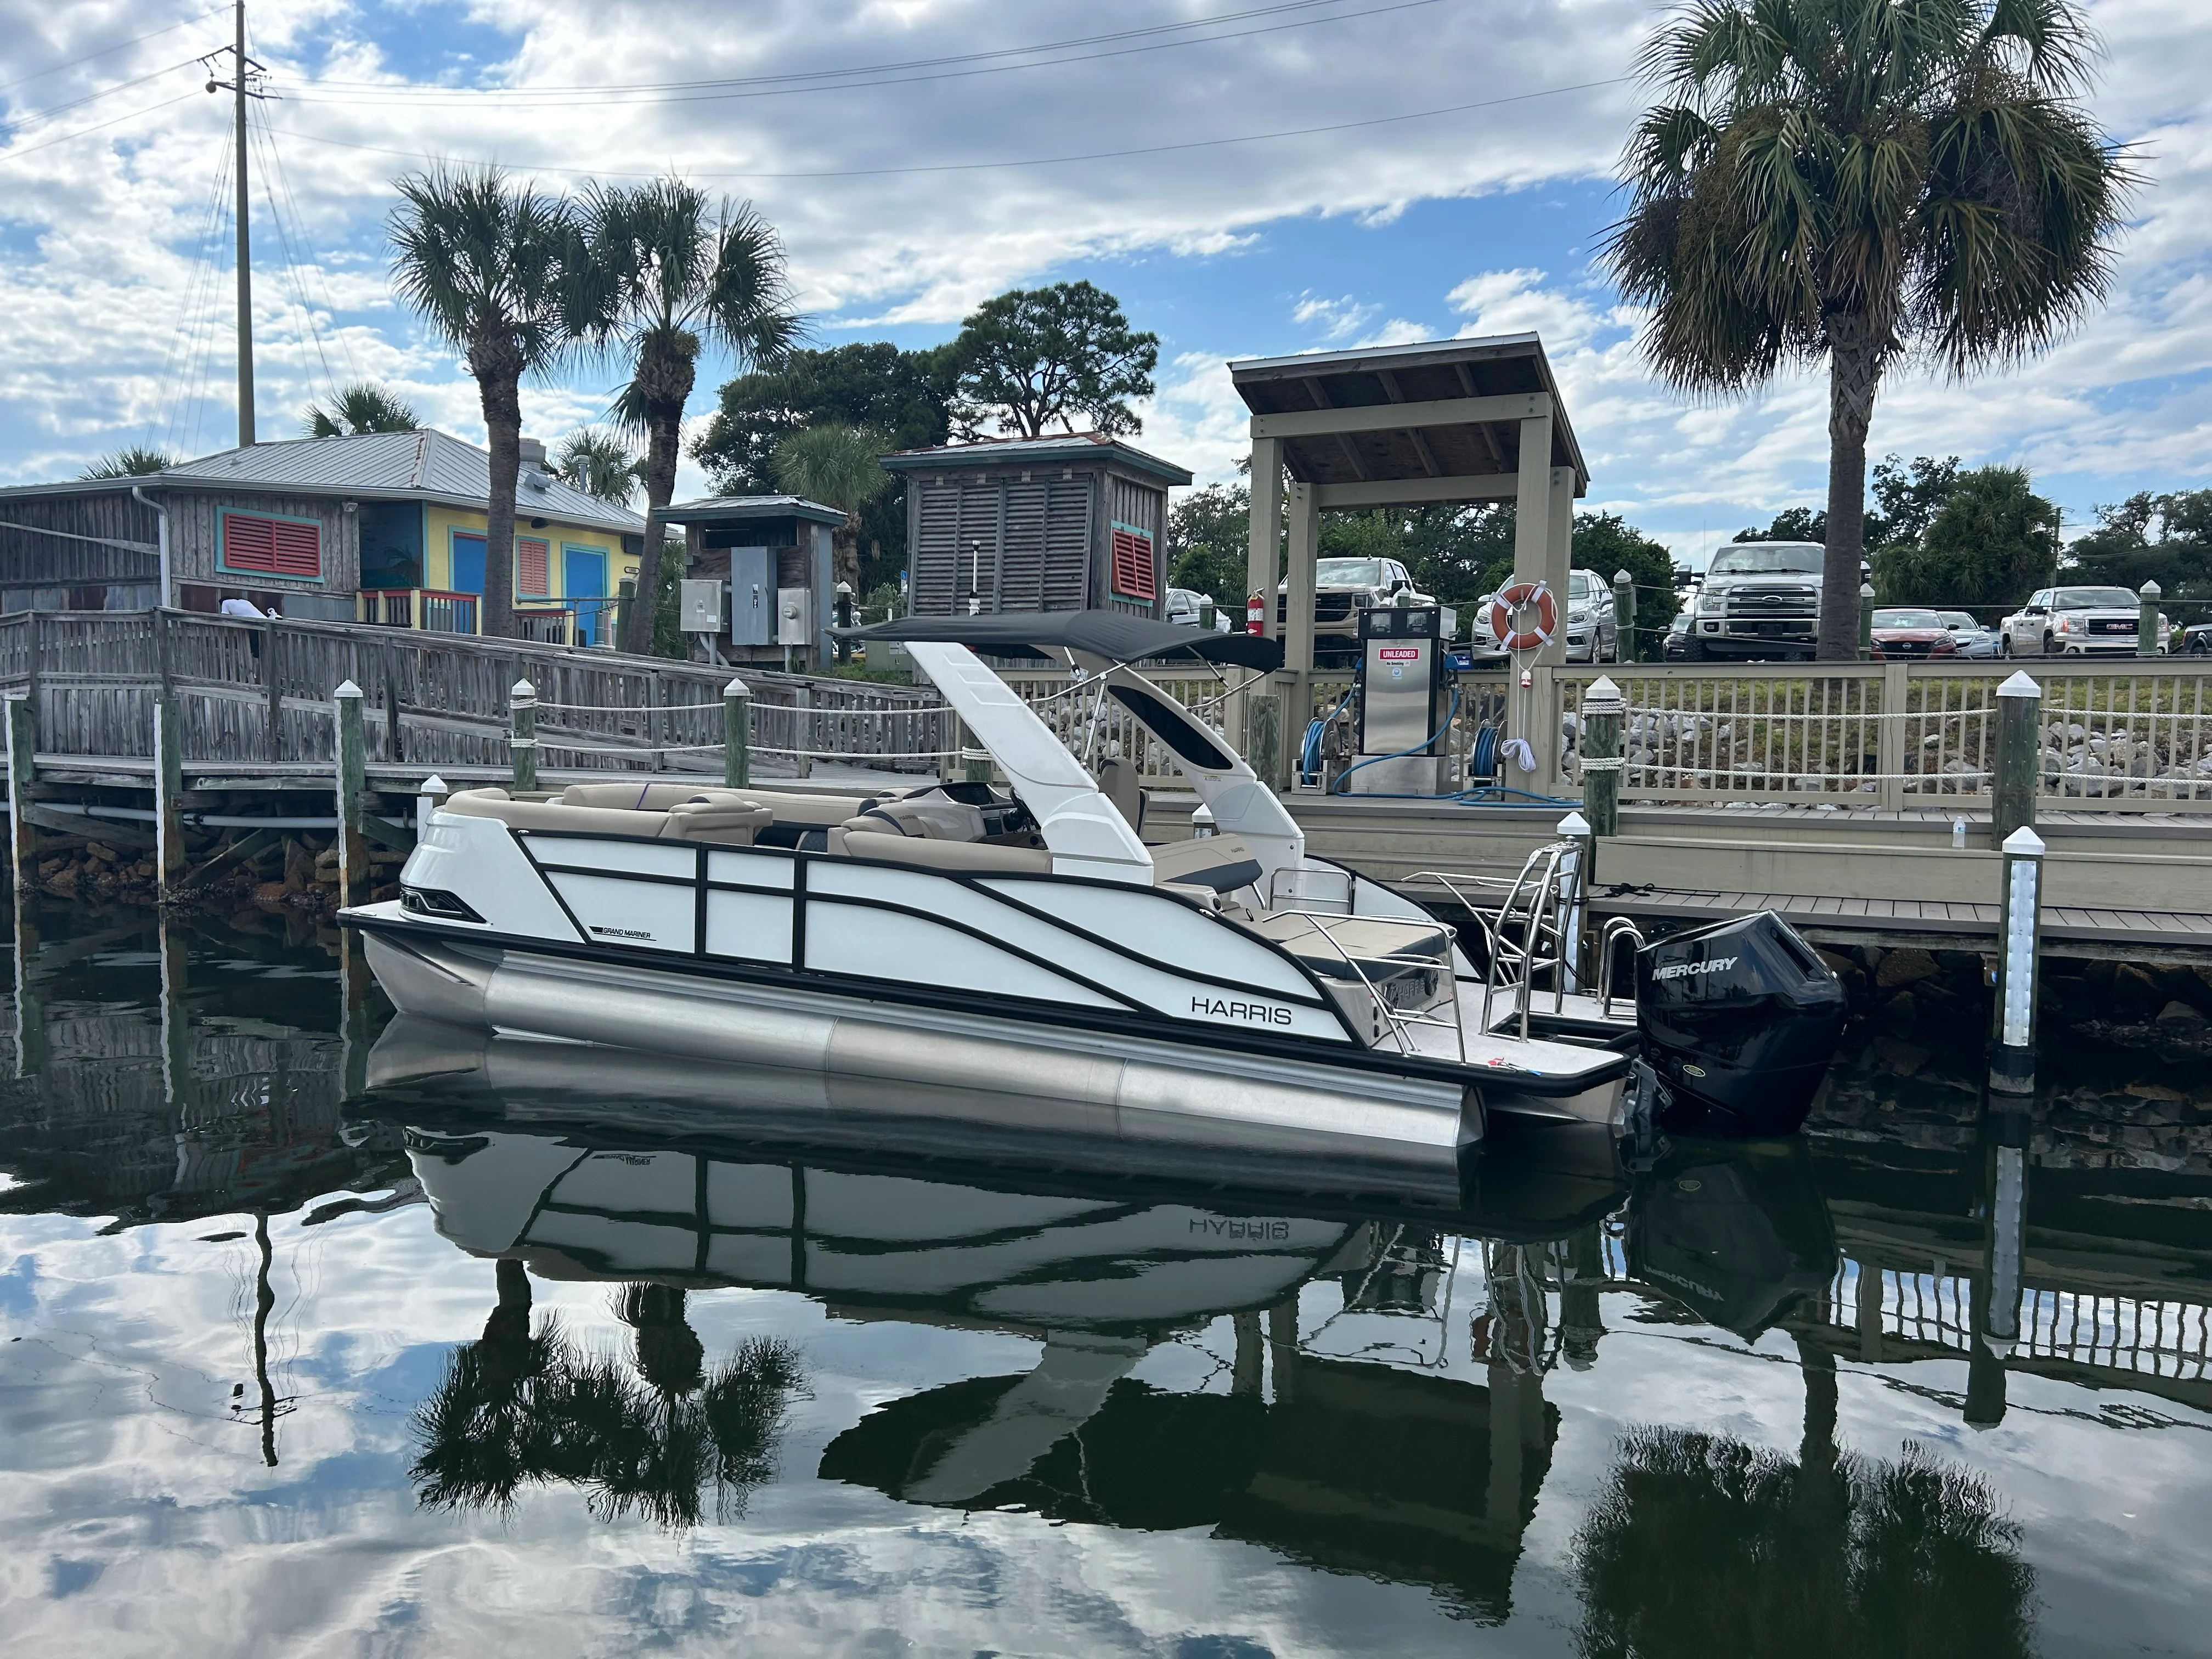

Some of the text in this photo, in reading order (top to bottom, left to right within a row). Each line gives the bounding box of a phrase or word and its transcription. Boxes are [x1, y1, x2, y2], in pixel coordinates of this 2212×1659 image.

[603, 927, 651, 939] GRAND MARINER
[1652, 956, 1738, 981] MERCURY
[1191, 996, 1291, 1025] HARRIS
